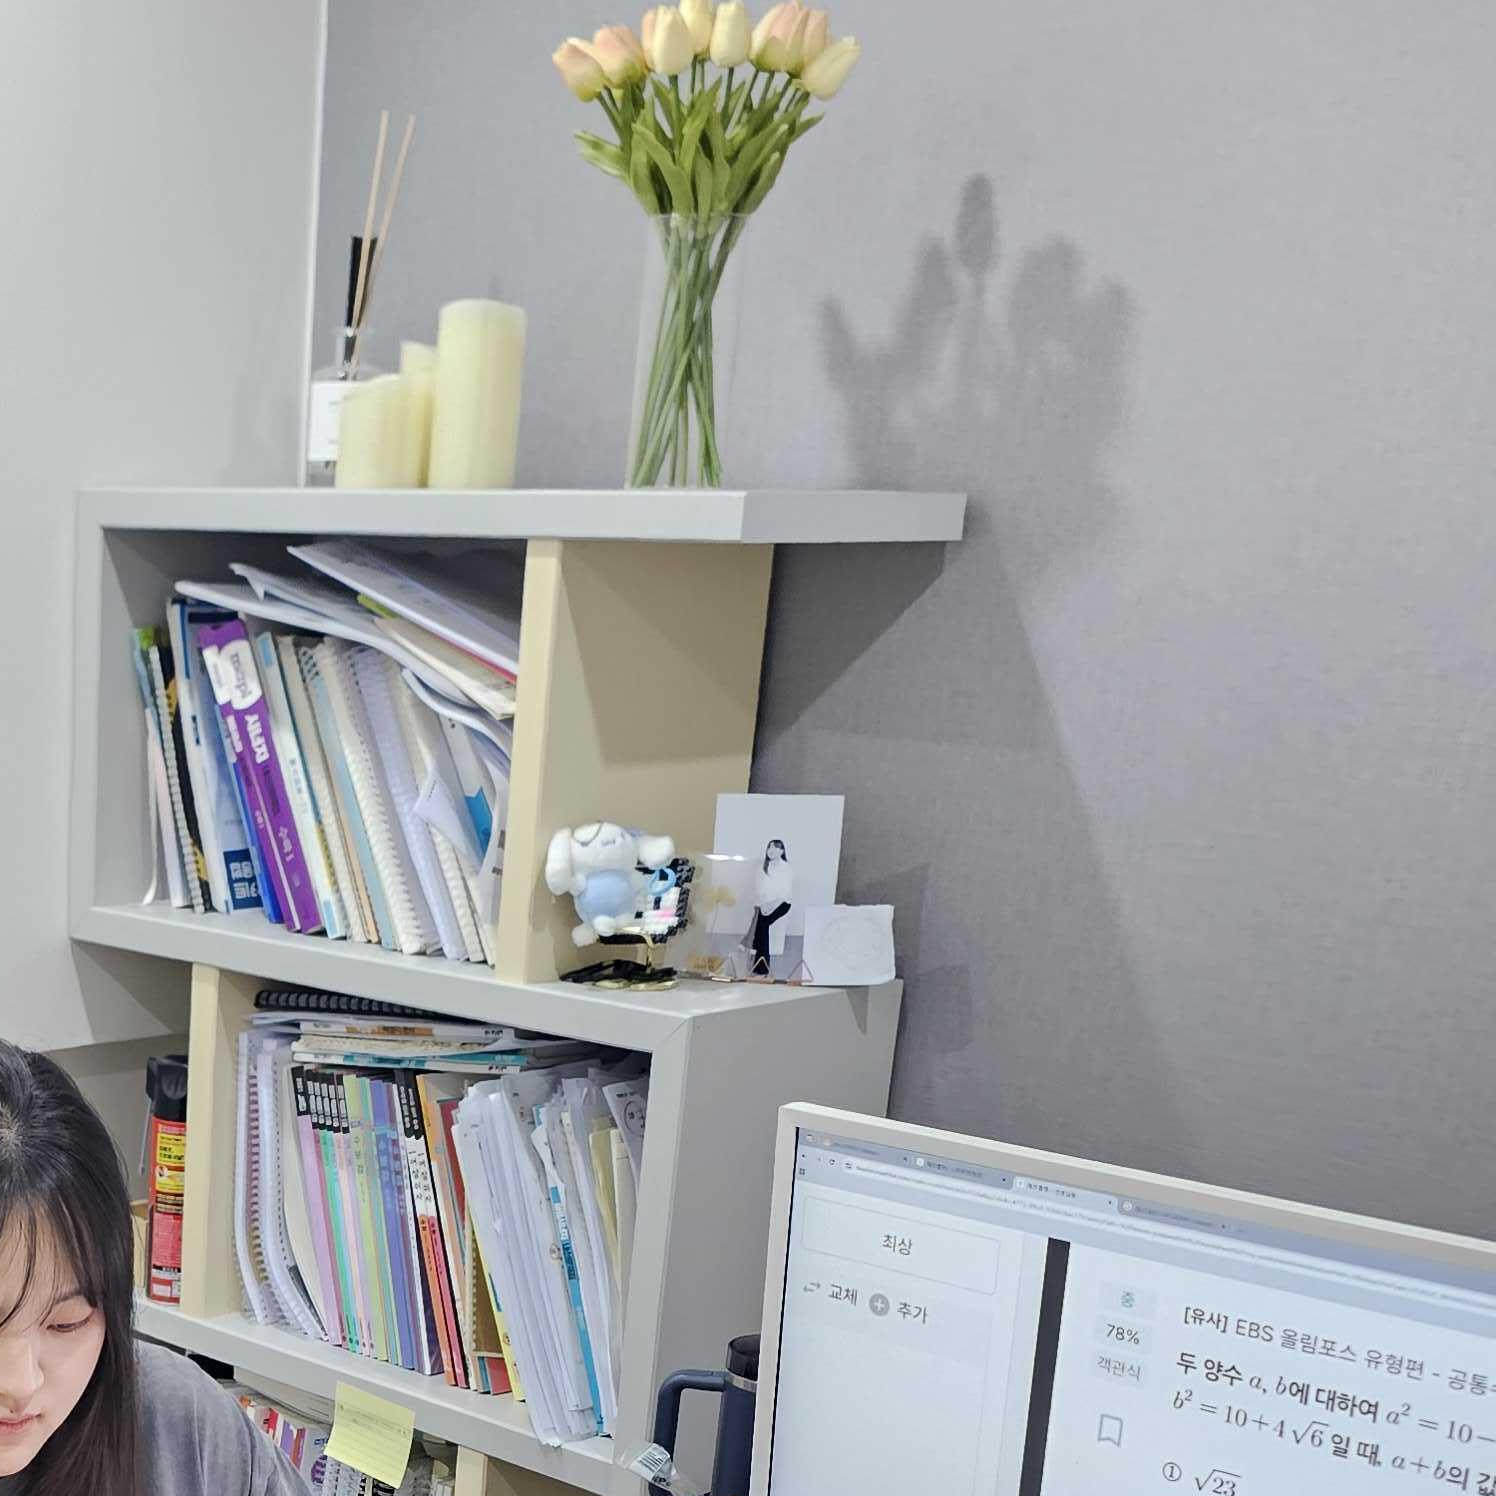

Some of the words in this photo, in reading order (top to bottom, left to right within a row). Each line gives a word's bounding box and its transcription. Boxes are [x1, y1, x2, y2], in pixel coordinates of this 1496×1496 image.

[881, 1233, 913, 1256] 최상
[828, 1283, 858, 1306] 교체
[896, 1301, 928, 1324] 추가
[1106, 1323, 1140, 1345] 78%
[1184, 1306, 1228, 1333] [유사]
[1235, 1318, 1275, 1342] EBS
[1280, 1328, 1357, 1362] 올림포스
[1365, 1349, 1425, 1381] 유형편
[1176, 1352, 1197, 1375] 두
[1204, 1359, 1243, 1386] 양수
[1315, 1387, 1380, 1424] 대하여
